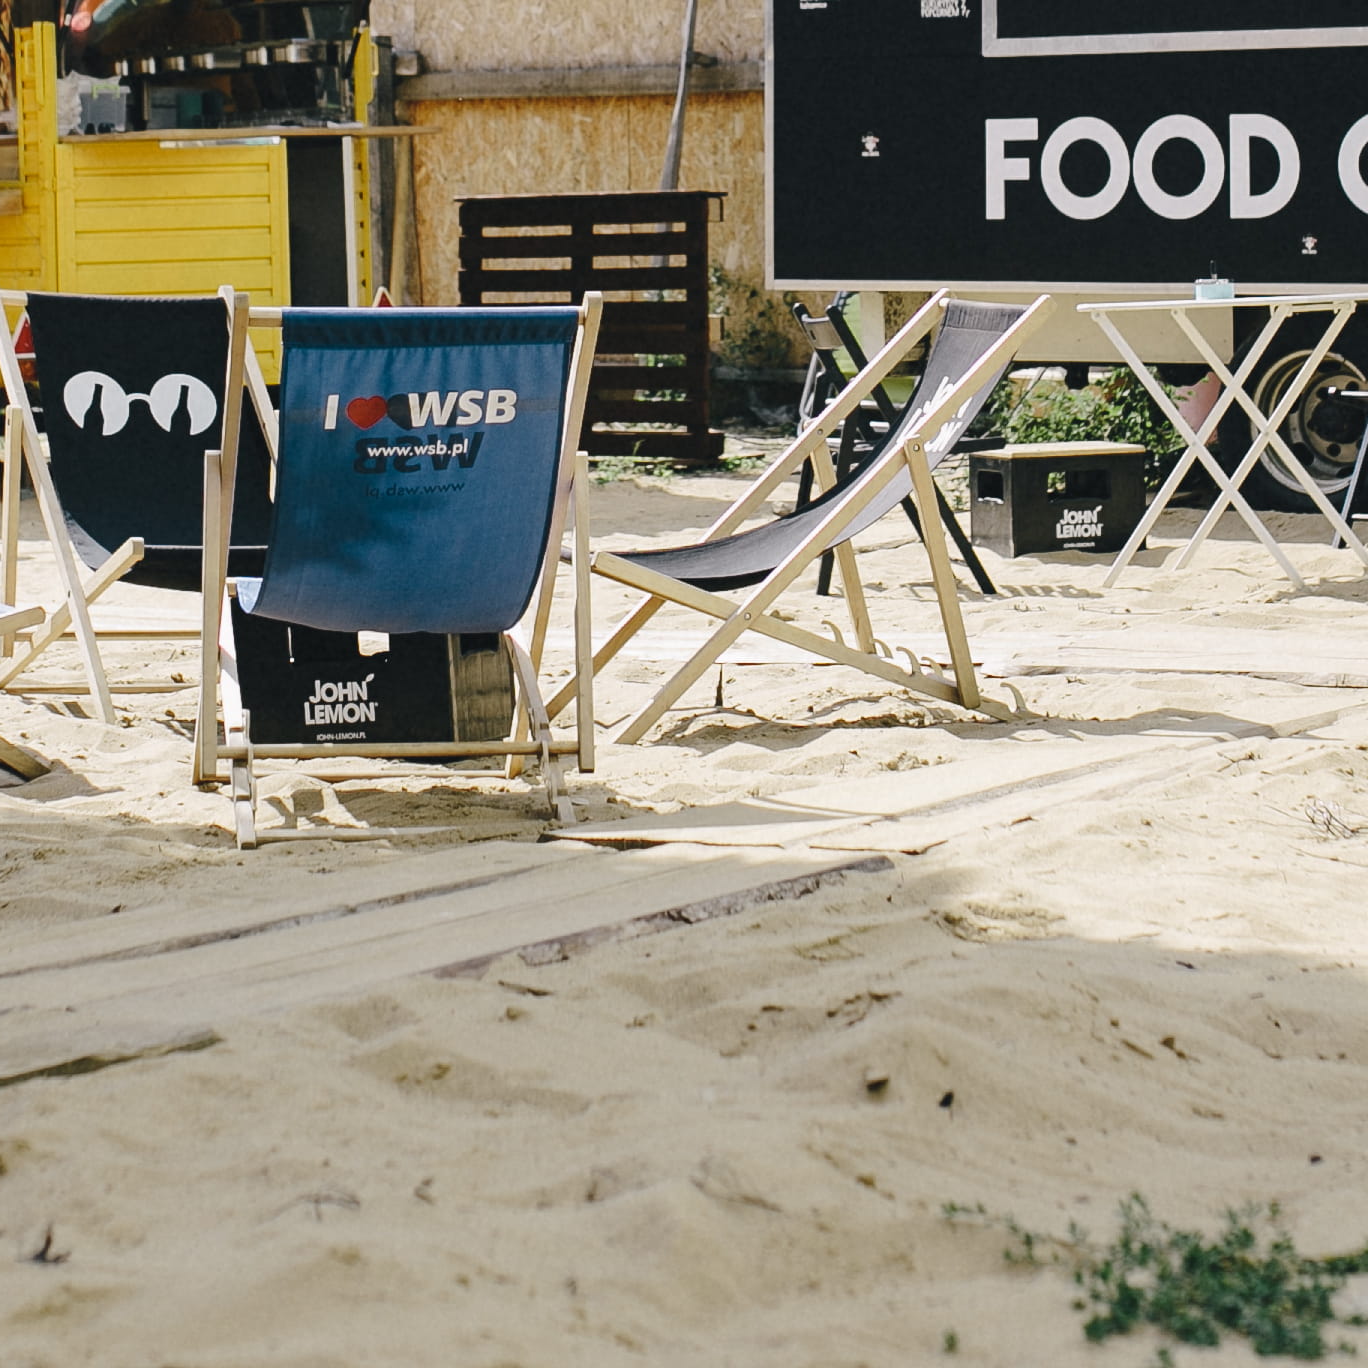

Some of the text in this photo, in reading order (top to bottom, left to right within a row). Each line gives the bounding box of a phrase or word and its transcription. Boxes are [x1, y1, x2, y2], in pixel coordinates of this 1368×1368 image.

[986, 113, 1301, 220] FOOD
[323, 389, 518, 430] I WSB
[367, 438, 469, 457] www.wsb.pl
[1059, 508, 1099, 525] JOHN
[1056, 523, 1102, 539] LEMON
[308, 679, 369, 704] JOHN
[304, 701, 376, 726] LEMON
